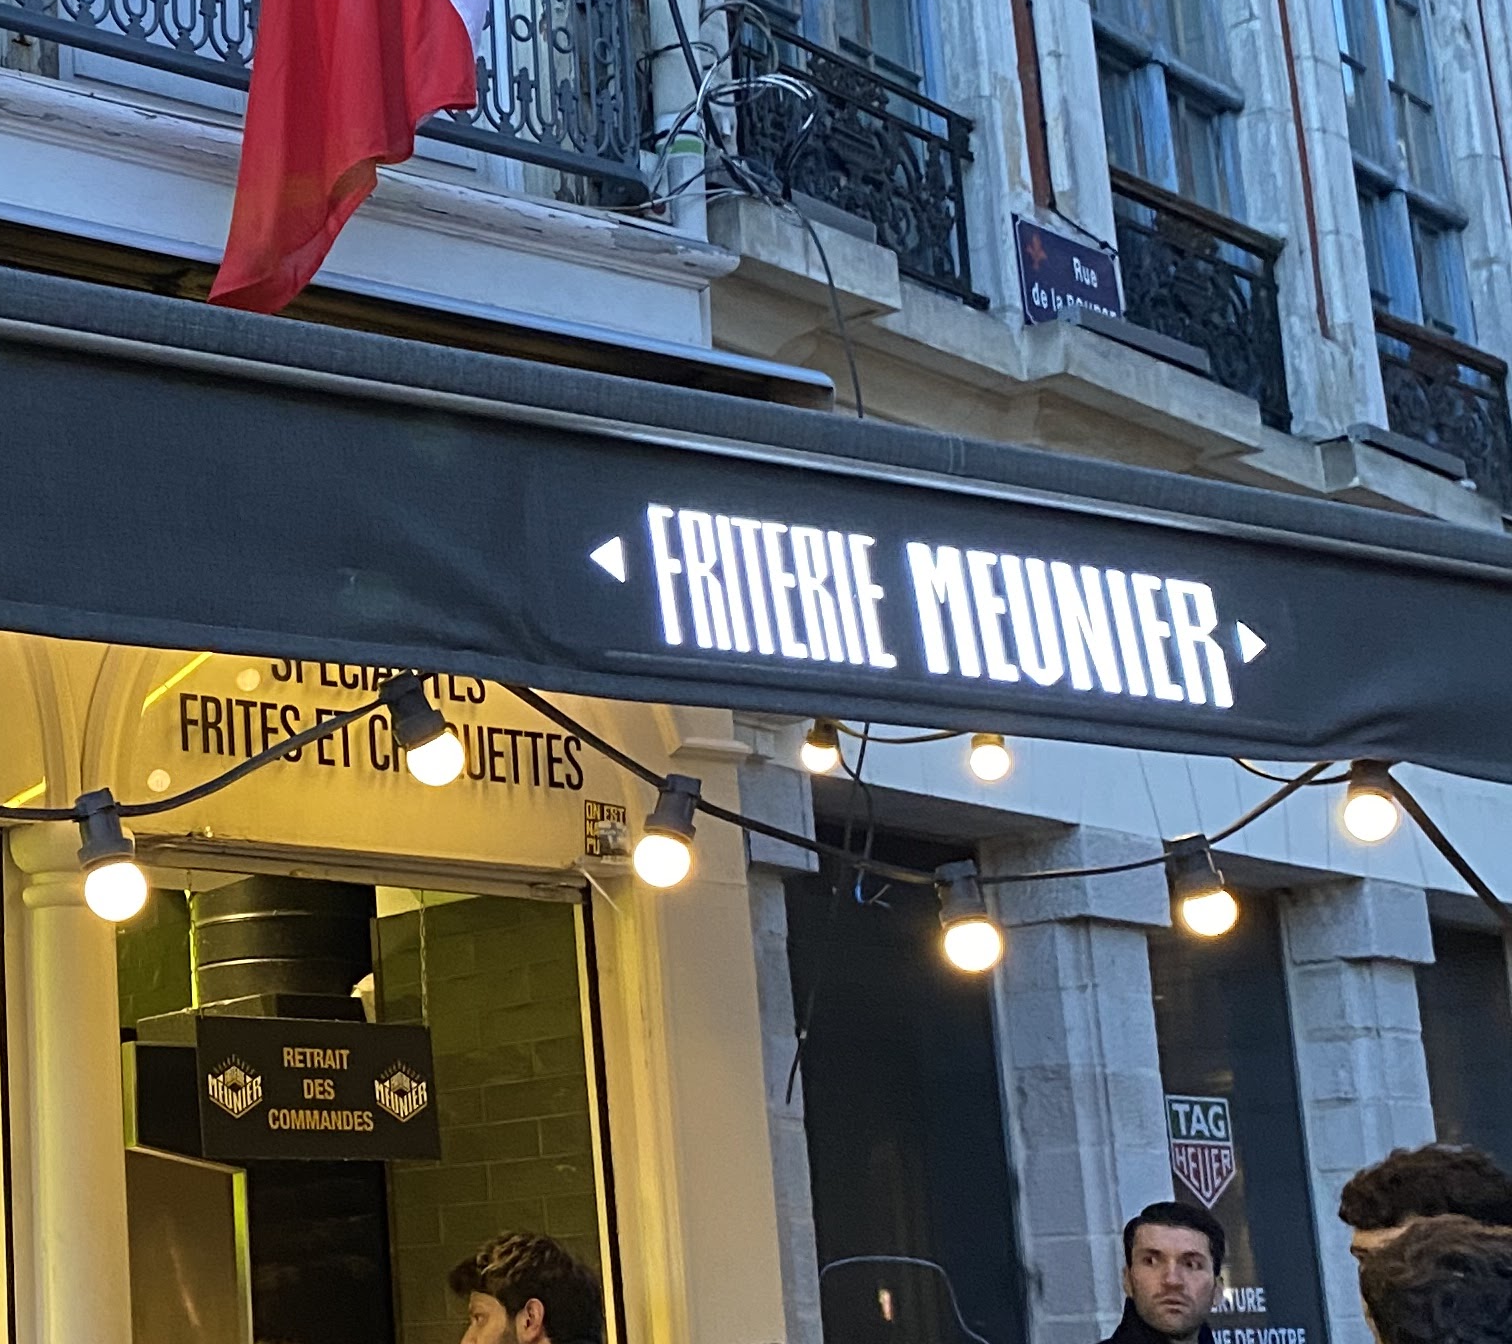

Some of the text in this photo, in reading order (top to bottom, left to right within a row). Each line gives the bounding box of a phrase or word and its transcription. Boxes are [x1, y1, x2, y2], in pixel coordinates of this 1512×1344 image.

[1072, 257, 1098, 288] Rue
[1031, 282, 1049, 309] de
[646, 502, 1234, 709] FRITERIE MEUNIER
[179, 692, 585, 791] FRITES ET CUETTES
[586, 802, 601, 821] ON
[283, 1047, 350, 1070] RETRAIT
[207, 1073, 262, 1114] MEUNIER
[303, 1078, 335, 1100] DES
[374, 1079, 428, 1118] MEUNIER
[268, 1108, 374, 1132] COMMANDES
[1171, 1103, 1227, 1138] TAG
[1175, 1147, 1232, 1197] HEUER
